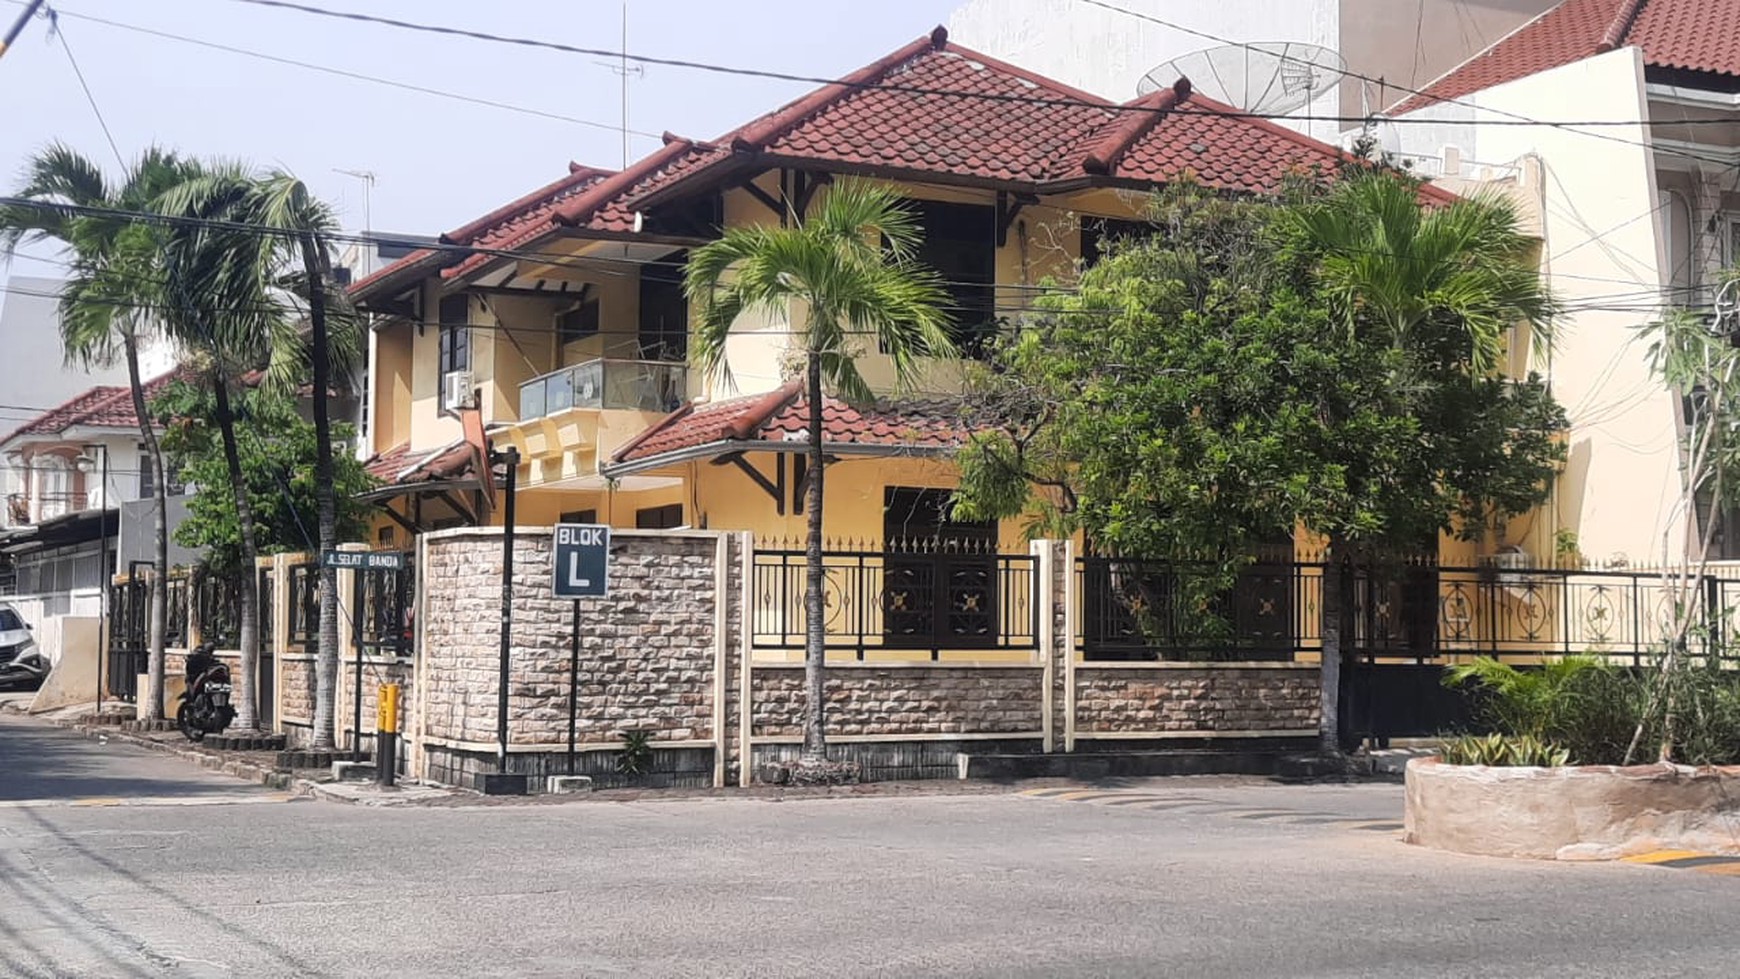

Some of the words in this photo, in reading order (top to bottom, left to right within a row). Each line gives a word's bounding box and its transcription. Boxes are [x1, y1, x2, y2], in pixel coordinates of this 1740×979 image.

[559, 528, 603, 545] BLOK
[368, 555, 399, 567] BANDA
[569, 551, 590, 587] L
